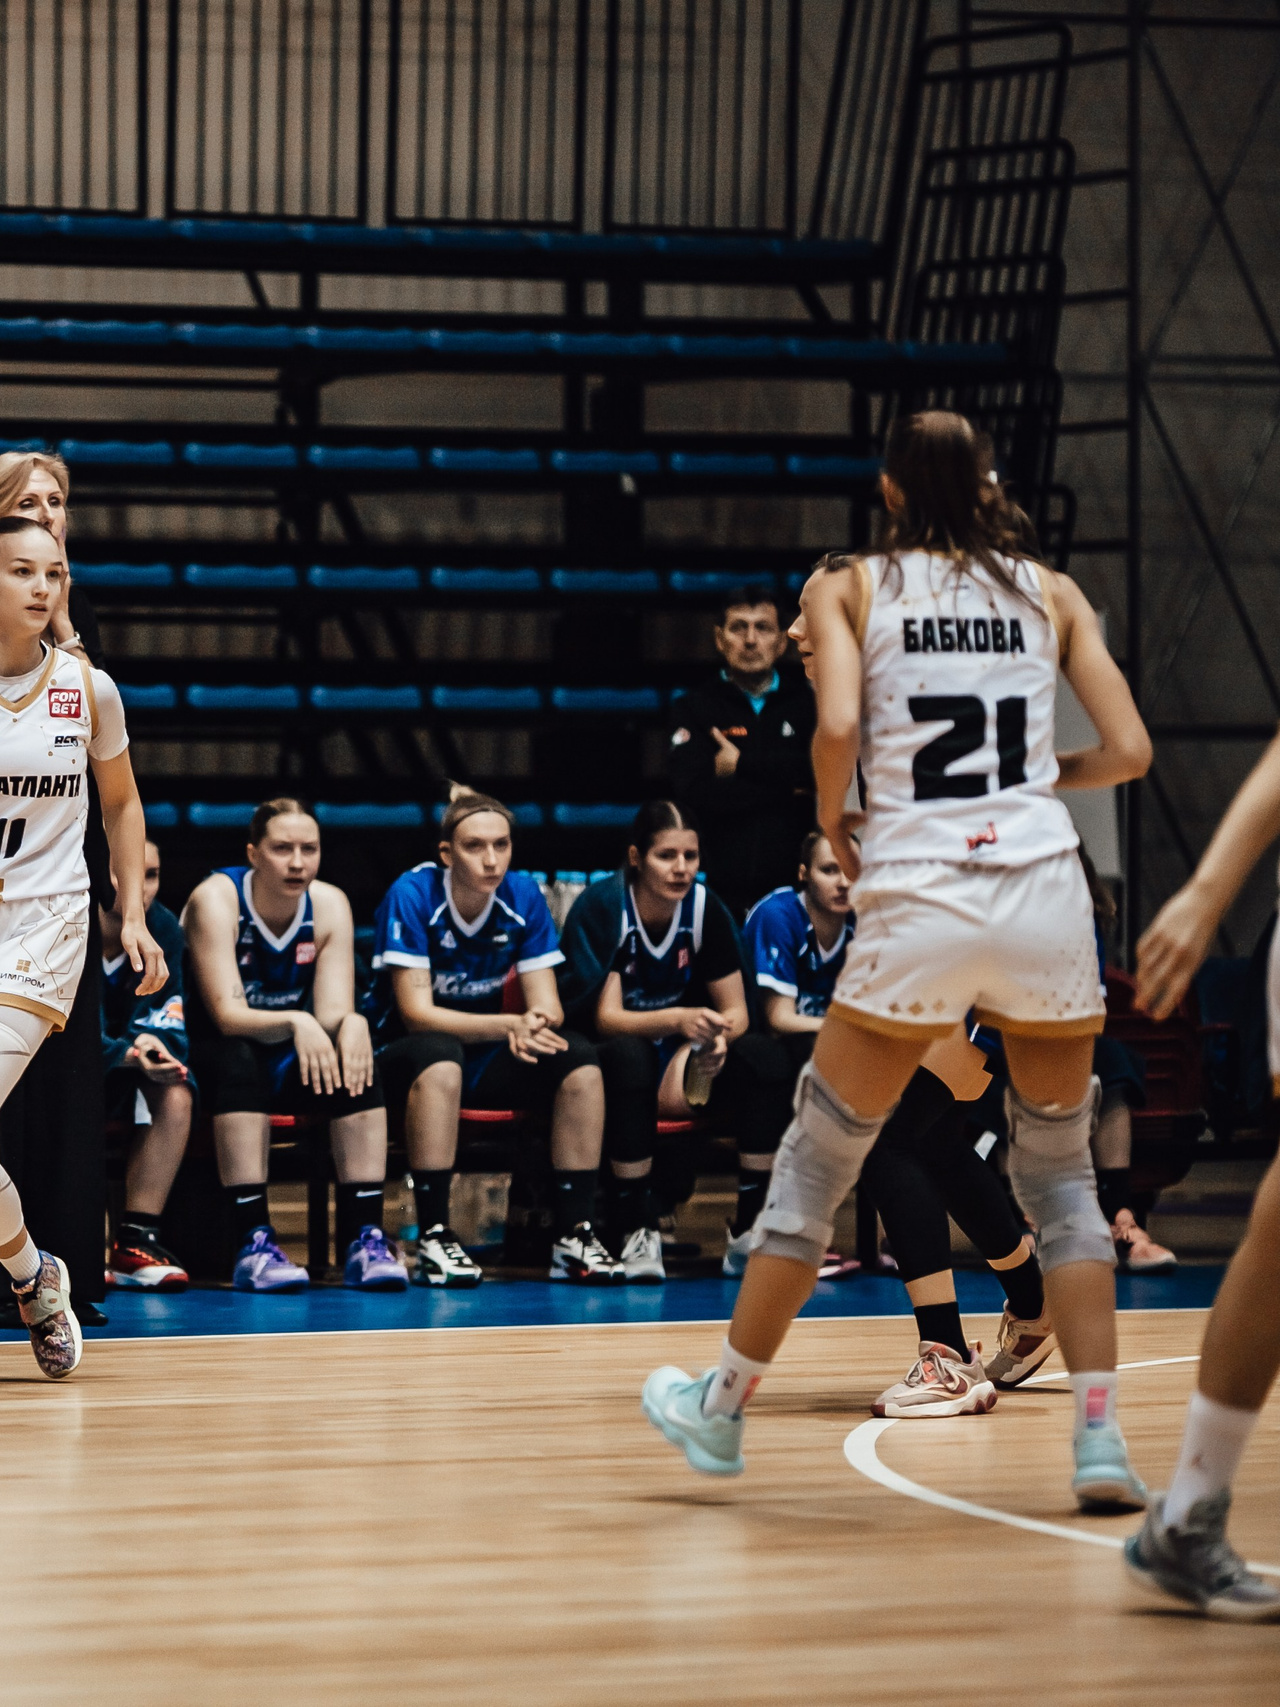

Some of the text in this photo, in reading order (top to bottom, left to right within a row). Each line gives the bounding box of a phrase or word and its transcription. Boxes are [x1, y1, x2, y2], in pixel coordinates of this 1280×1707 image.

[903, 618, 1026, 653] БАБКОВА
[50, 691, 79, 703] FON
[51, 702, 79, 715] BET
[908, 695, 1028, 801] 21
